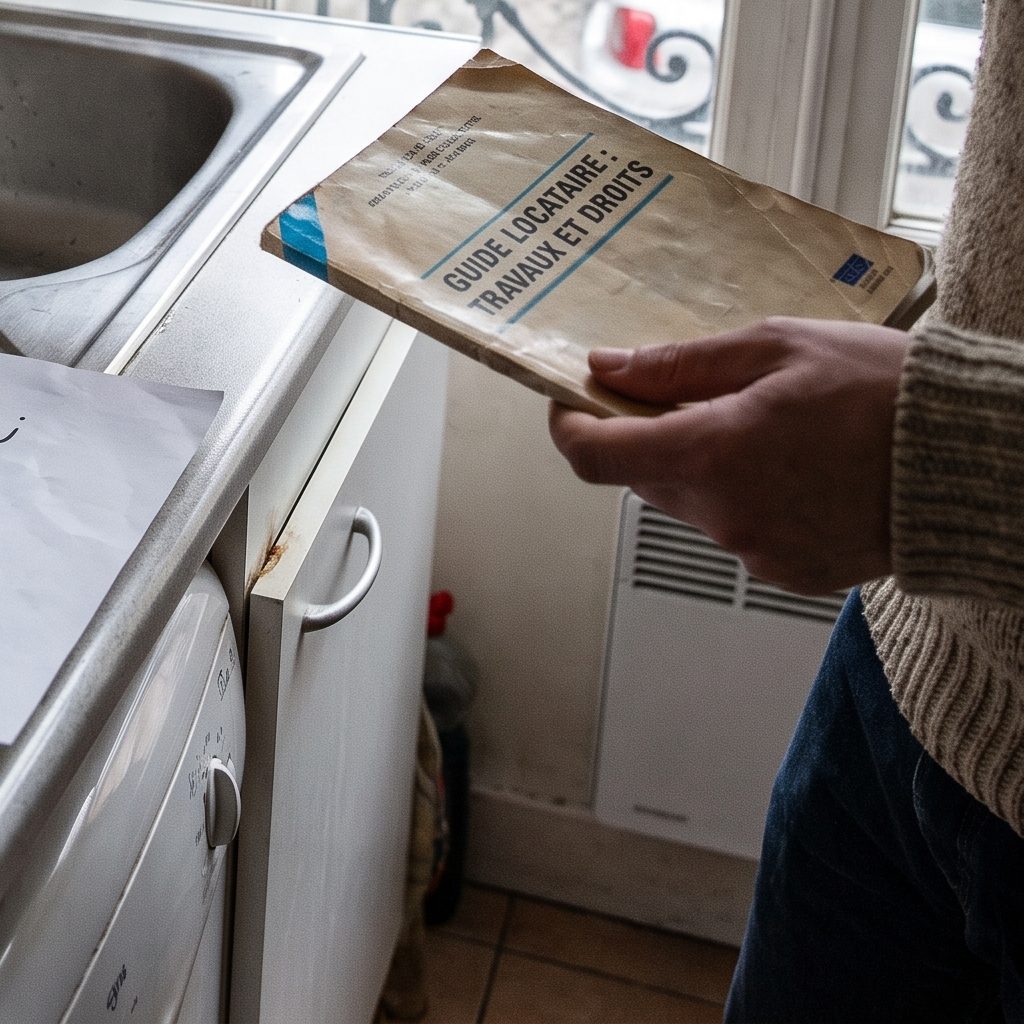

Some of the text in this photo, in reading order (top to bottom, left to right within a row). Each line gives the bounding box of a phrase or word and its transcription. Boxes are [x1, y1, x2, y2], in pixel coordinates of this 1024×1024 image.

[443, 238, 513, 292] GUIDE
[500, 154, 608, 244] LOCATAIRE
[467, 160, 654, 316] TRAVAUX ET DROITS
